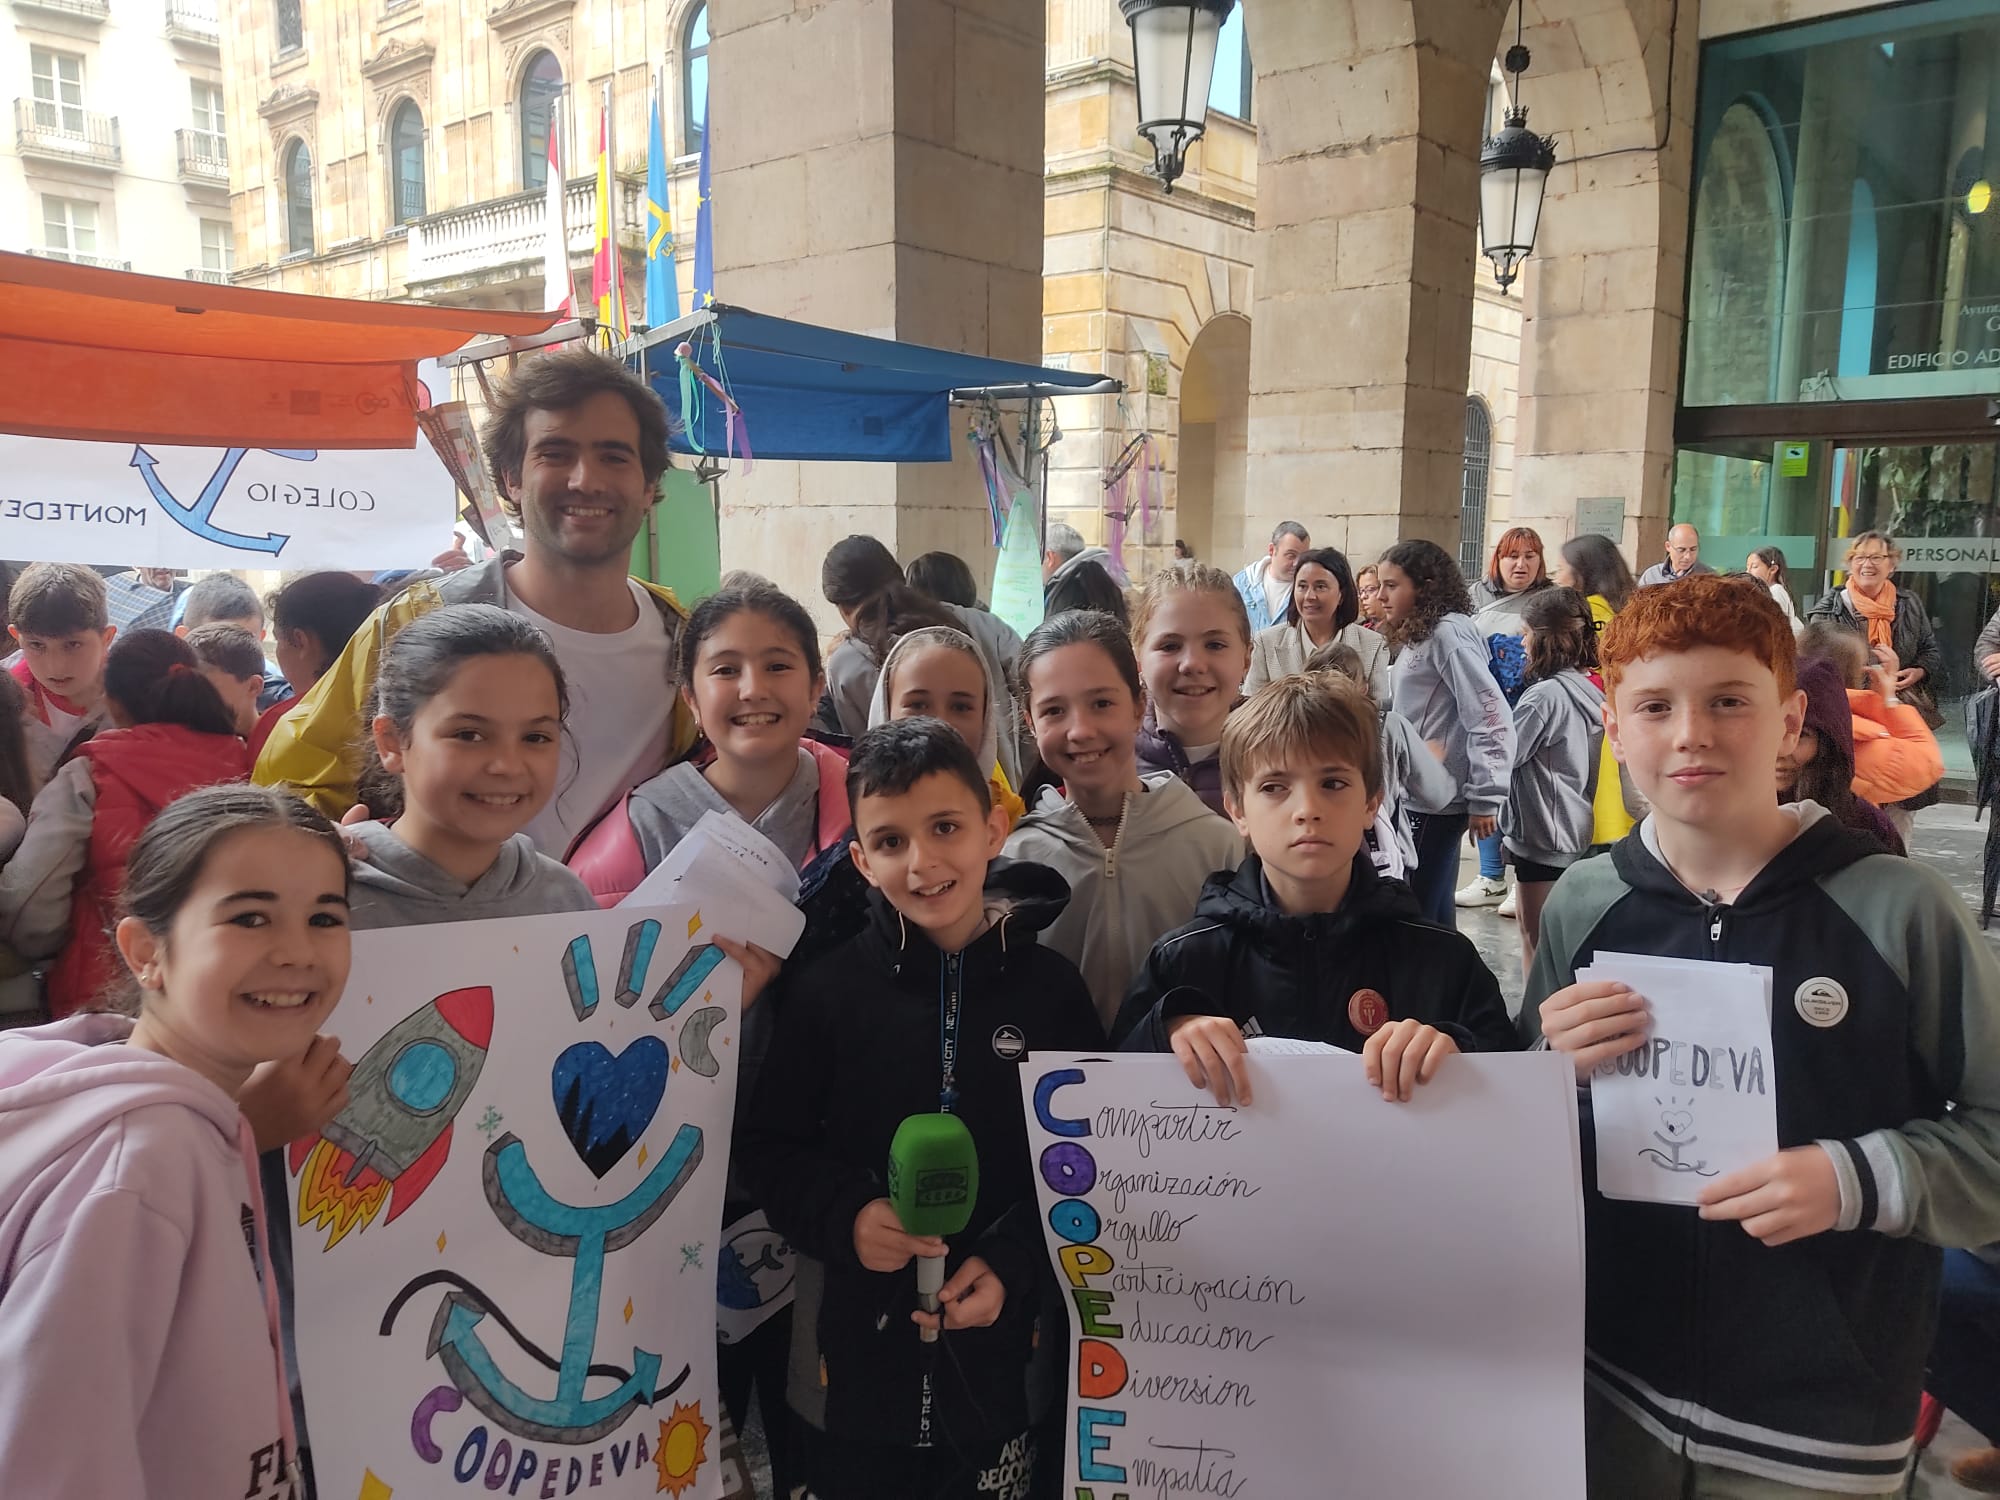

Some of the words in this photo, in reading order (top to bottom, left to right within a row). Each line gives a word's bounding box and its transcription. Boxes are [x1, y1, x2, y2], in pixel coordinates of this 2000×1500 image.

[1888, 350, 1969, 369] EDIFICIO
[1906, 548, 2000, 562] PERSONAL
[1033, 1068, 1241, 1158] Compartir
[1040, 1141, 1262, 1213] Organización
[1048, 1198, 1199, 1260] Orgullo
[1057, 1244, 1305, 1311] Participación
[1072, 1289, 1275, 1352] Educacion
[1078, 1338, 1256, 1407] Diversion
[411, 1385, 650, 1500] COOPEDEVA
[1000, 1431, 1028, 1465] ART
